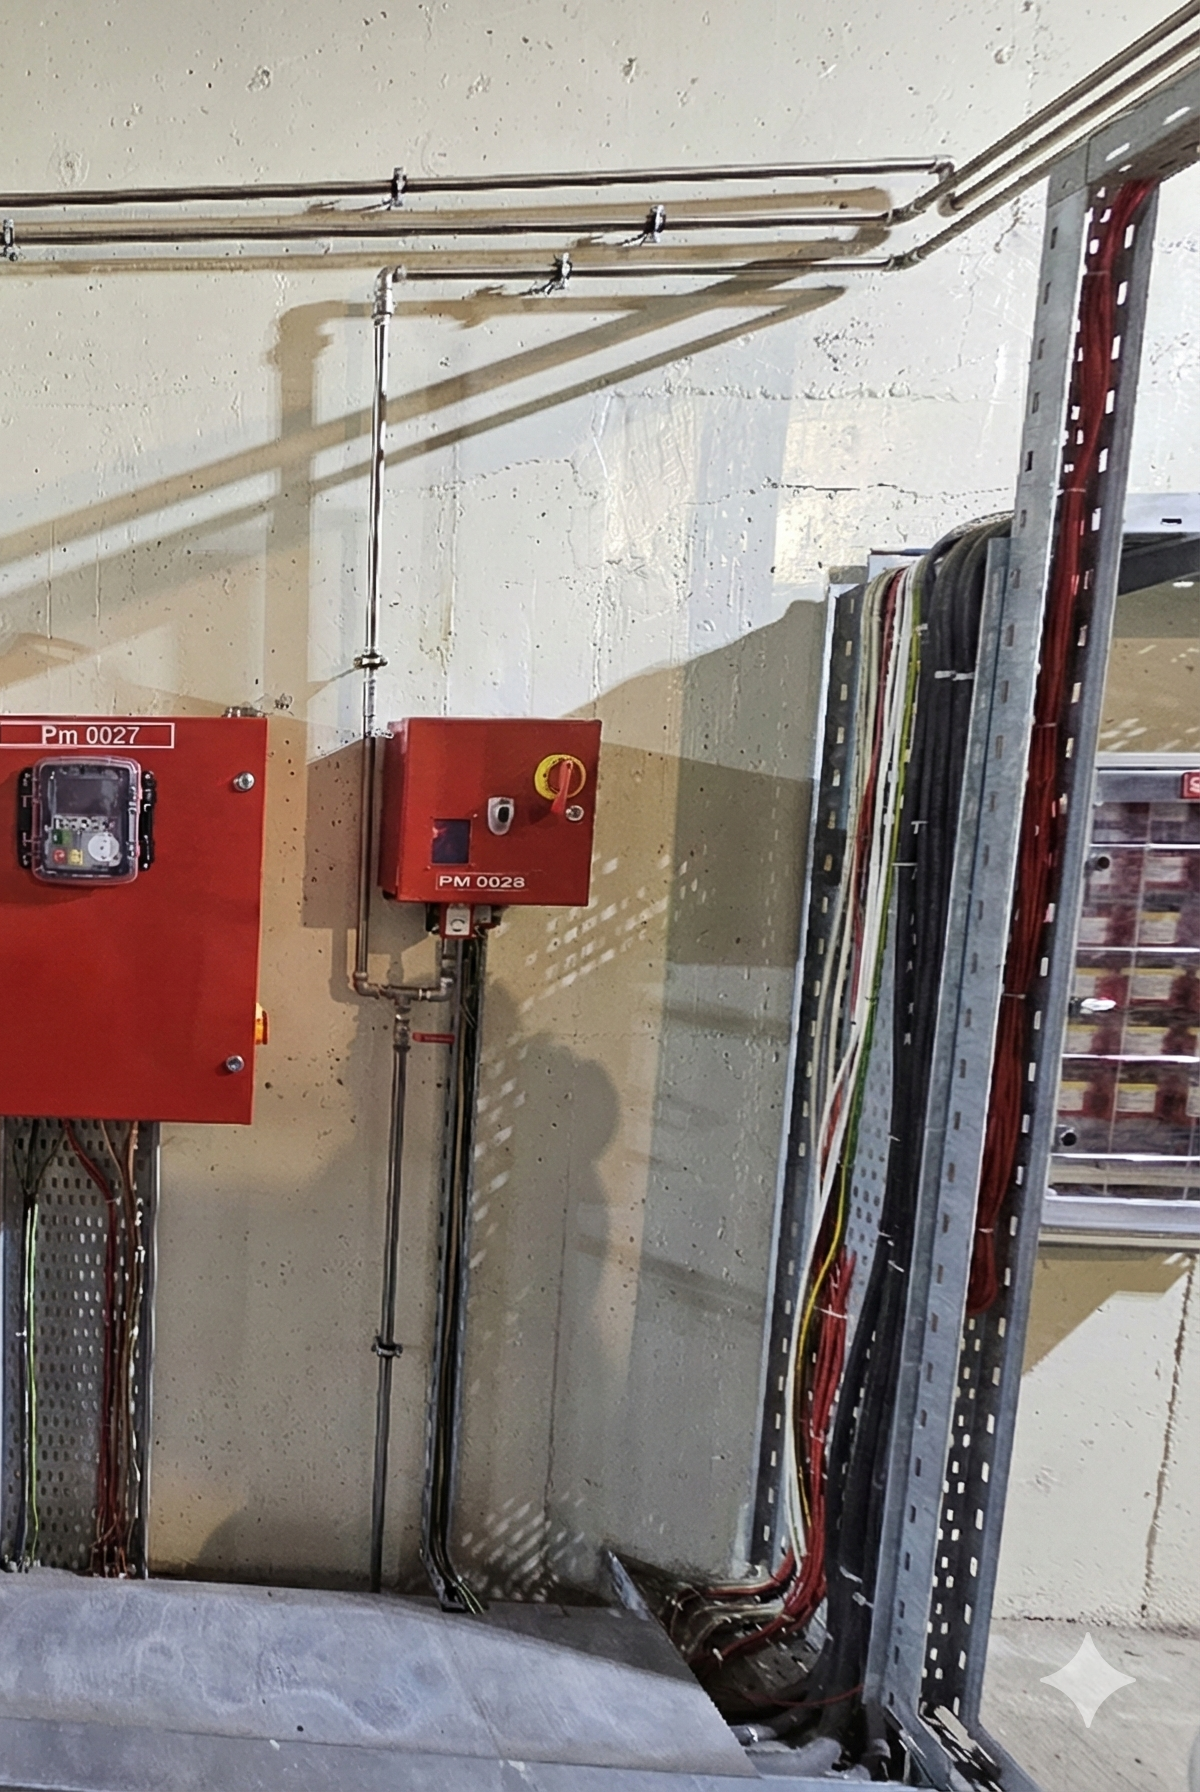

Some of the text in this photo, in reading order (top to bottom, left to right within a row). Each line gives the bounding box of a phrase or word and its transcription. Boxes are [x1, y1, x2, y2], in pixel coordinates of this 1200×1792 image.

[41, 725, 140, 745] Pm 0027
[439, 875, 471, 888] PM
